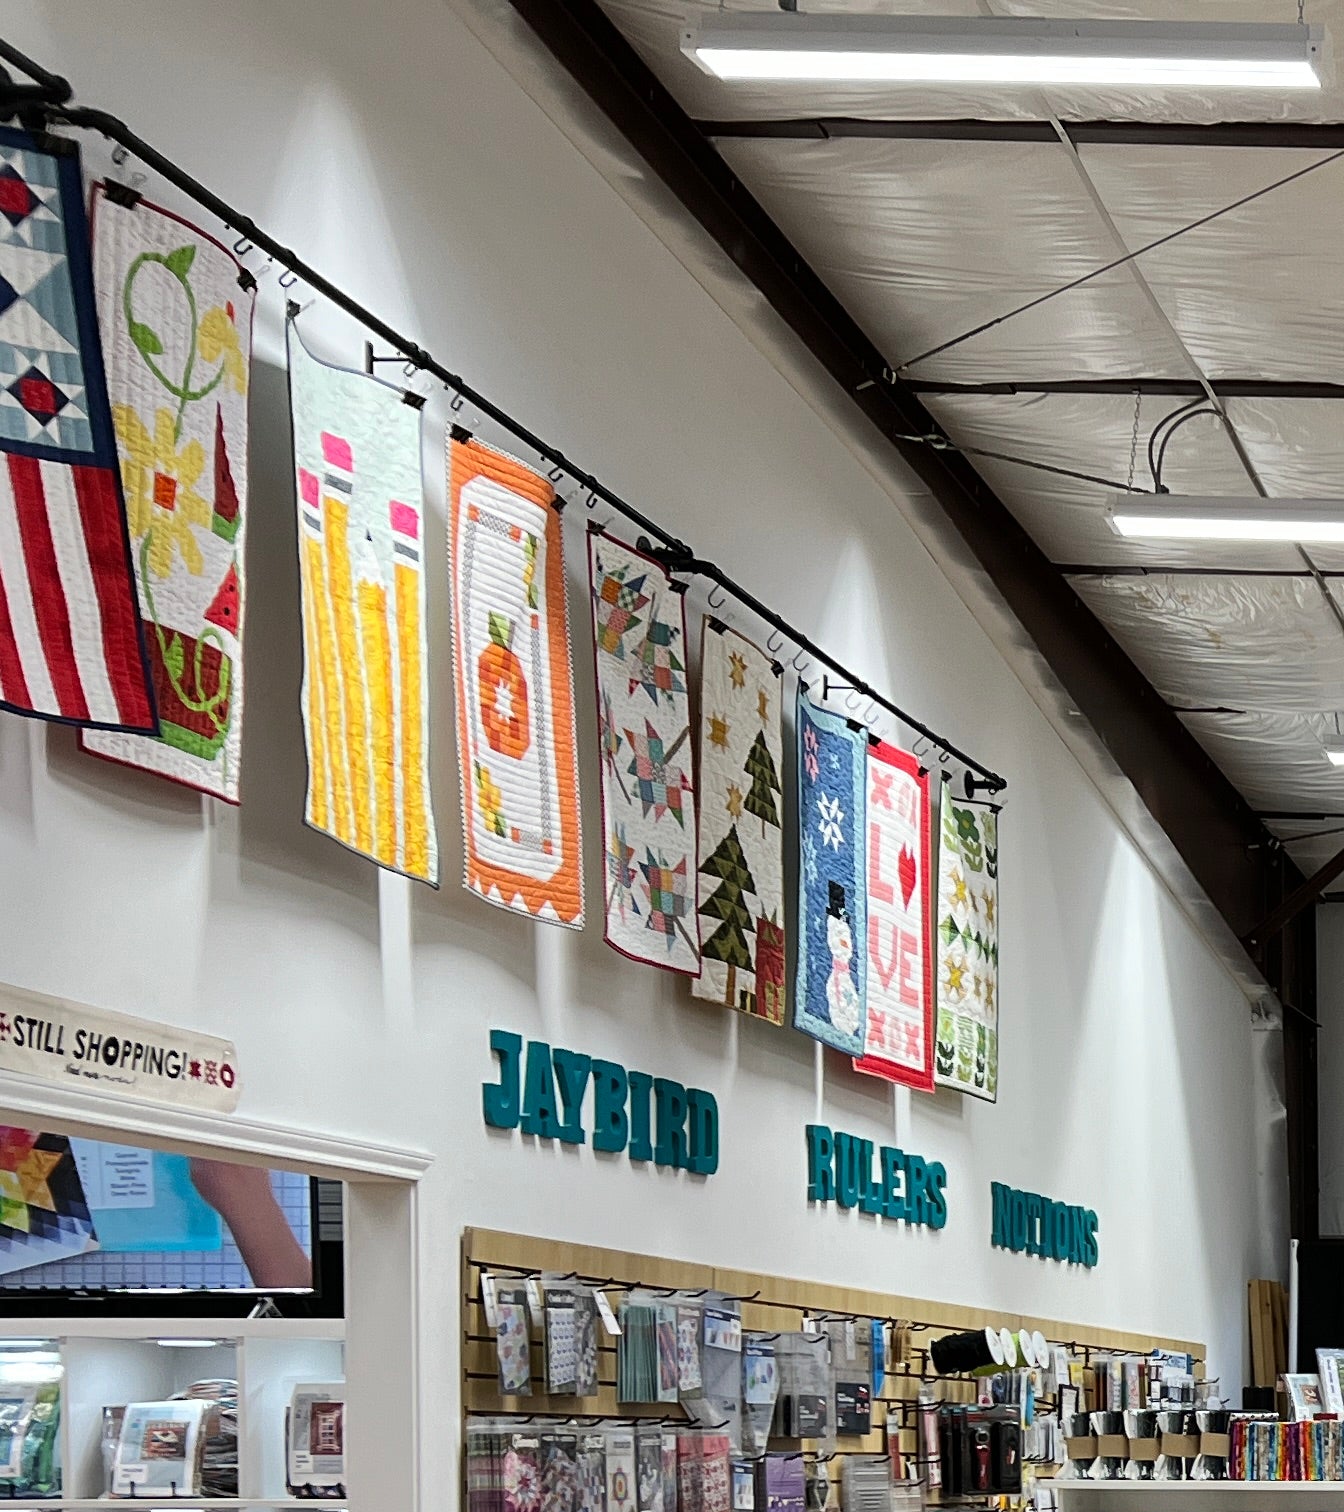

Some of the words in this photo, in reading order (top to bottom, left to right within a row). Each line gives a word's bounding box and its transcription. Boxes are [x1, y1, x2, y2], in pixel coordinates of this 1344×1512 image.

[13, 1014, 65, 1056] STILL
[72, 1029, 188, 1082] SHOPPING!
[483, 1029, 719, 1176] JAYBIRD
[806, 1124, 947, 1229] RULERS
[991, 1181, 1098, 1267] NOTIONS
